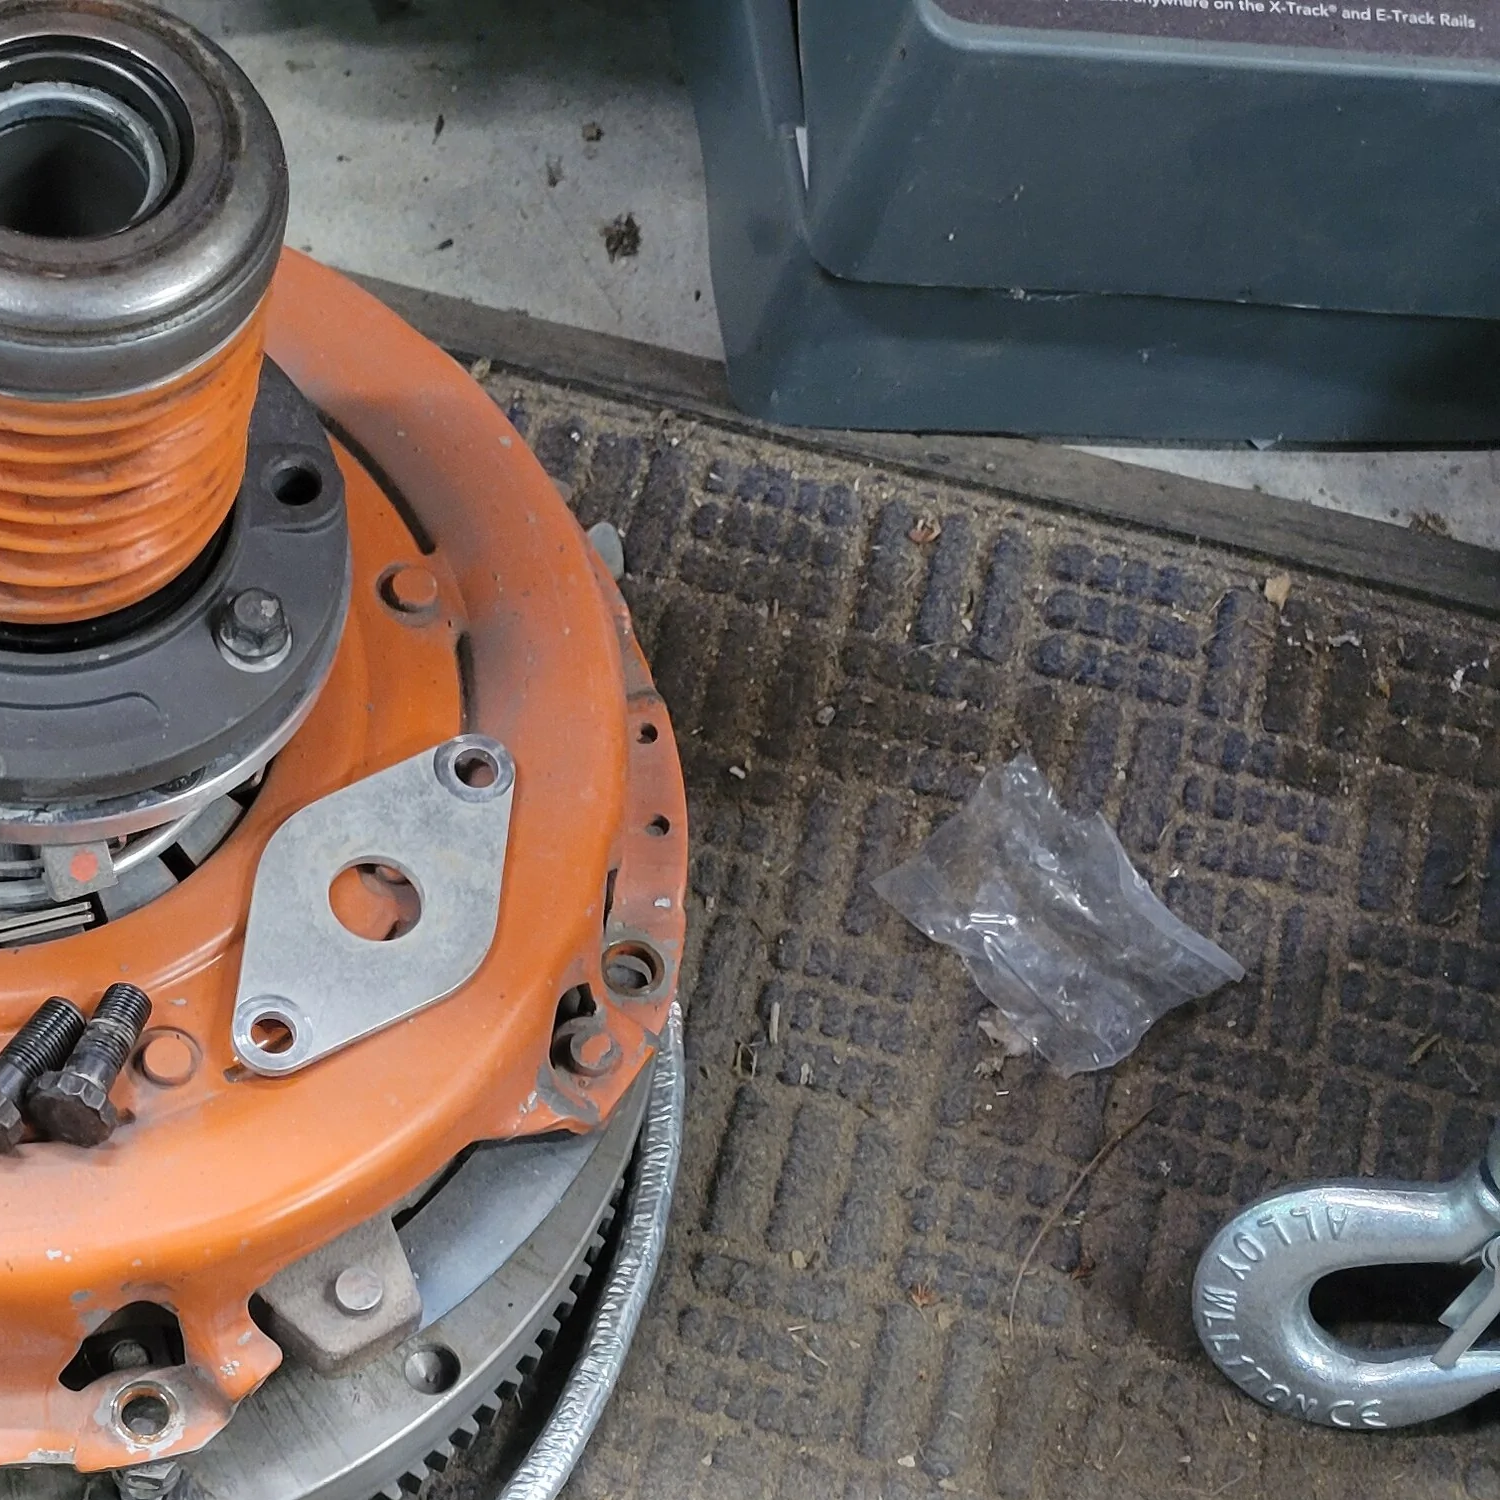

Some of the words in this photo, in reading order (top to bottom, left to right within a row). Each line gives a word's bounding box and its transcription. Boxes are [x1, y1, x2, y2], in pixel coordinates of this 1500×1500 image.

[1213, 1, 1234, 11] on
[1239, 0, 1265, 12] the
[1341, 7, 1371, 21] and
[1375, 8, 1436, 26] E-Track
[1439, 12, 1476, 29] Rails
[1217, 1205, 1348, 1281] ALLOY
